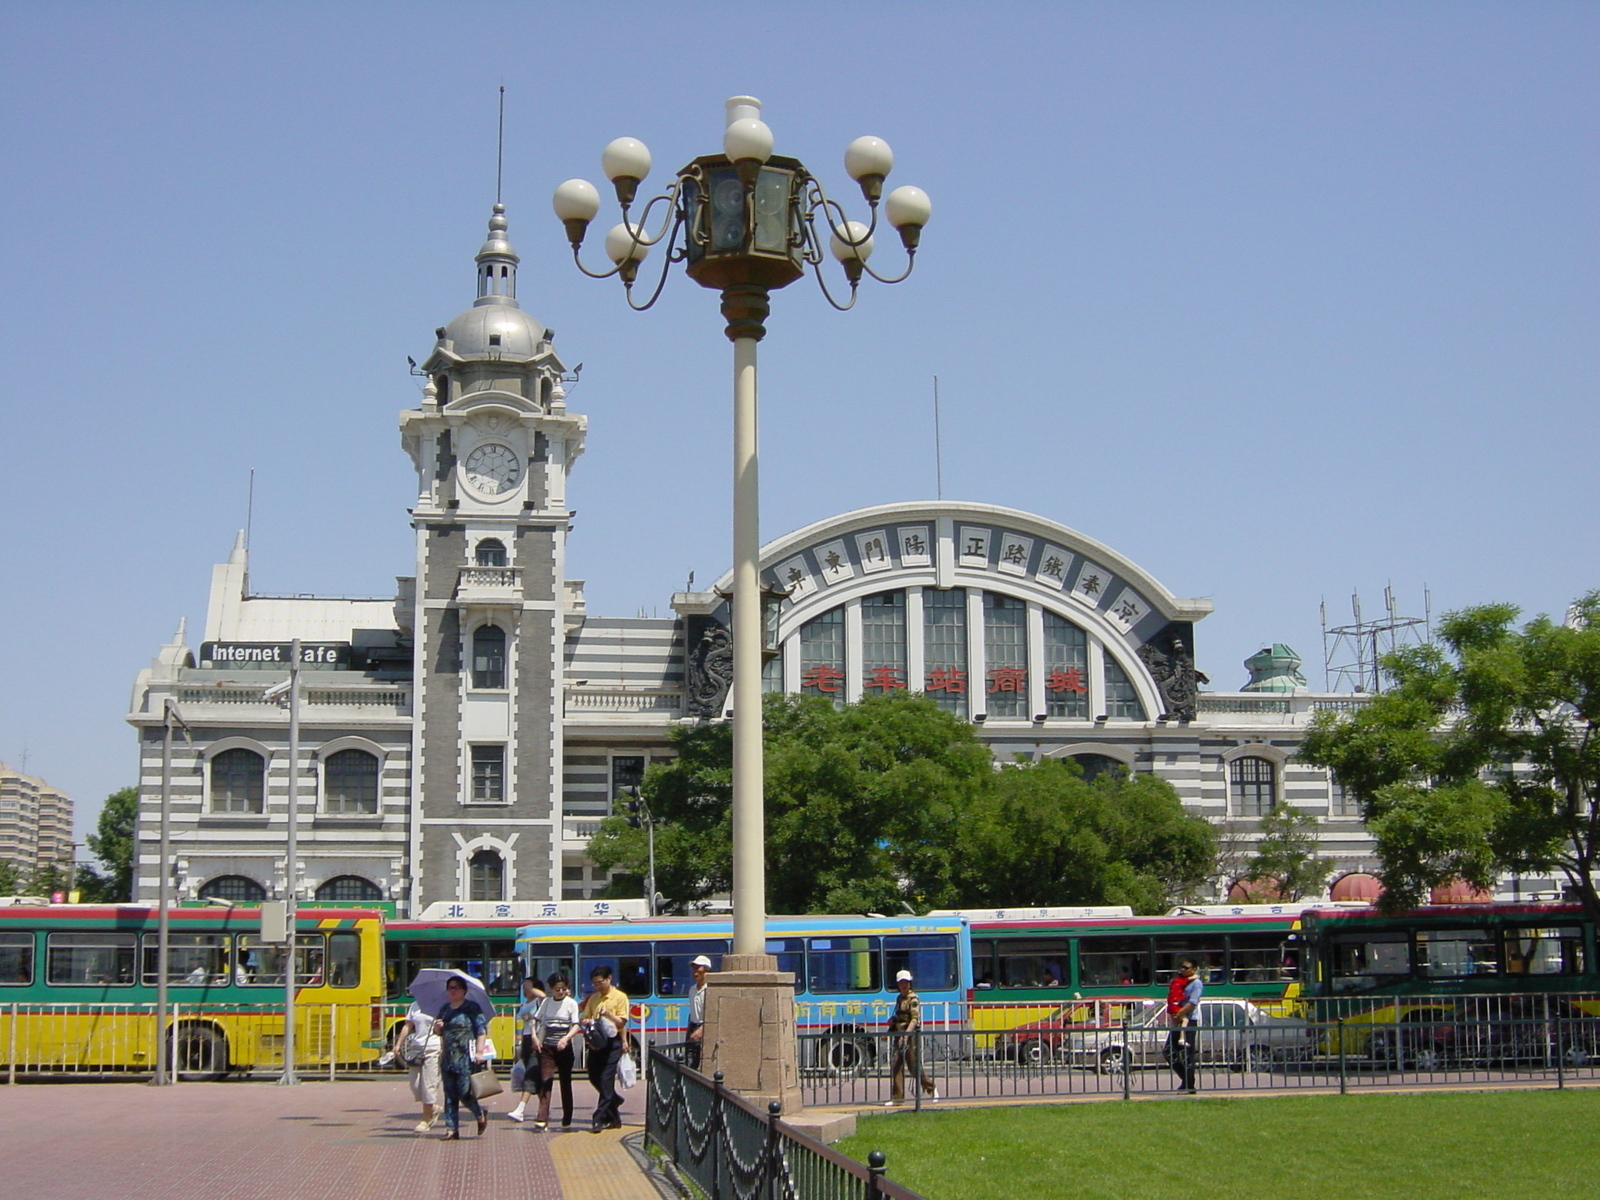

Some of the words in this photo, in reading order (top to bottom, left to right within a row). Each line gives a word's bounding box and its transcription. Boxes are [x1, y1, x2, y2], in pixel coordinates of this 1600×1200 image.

[212, 644, 281, 661] Internet
[801, 665, 1088, 694] 老车站商城
